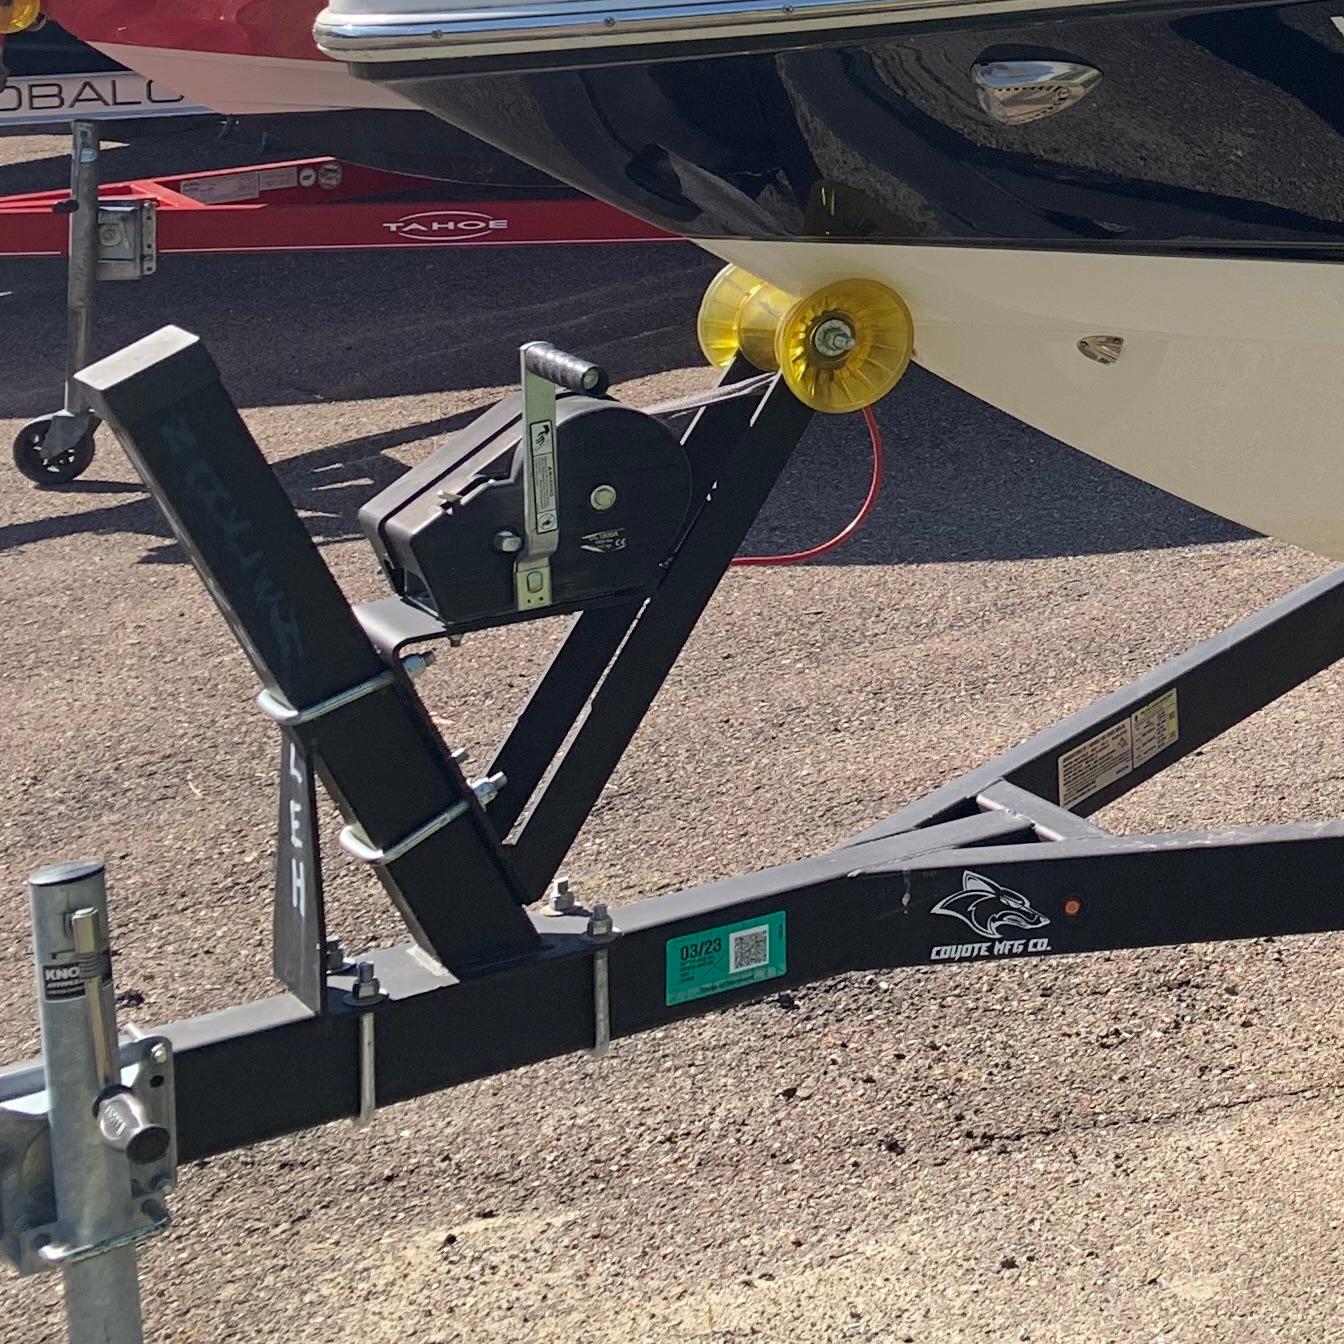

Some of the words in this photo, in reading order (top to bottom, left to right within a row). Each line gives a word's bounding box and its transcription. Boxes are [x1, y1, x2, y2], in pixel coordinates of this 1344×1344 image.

[382, 219, 508, 233] TAHOE
[680, 937, 722, 962] 03/23
[931, 942, 991, 960] COYOTE
[994, 940, 1026, 955] MFG
